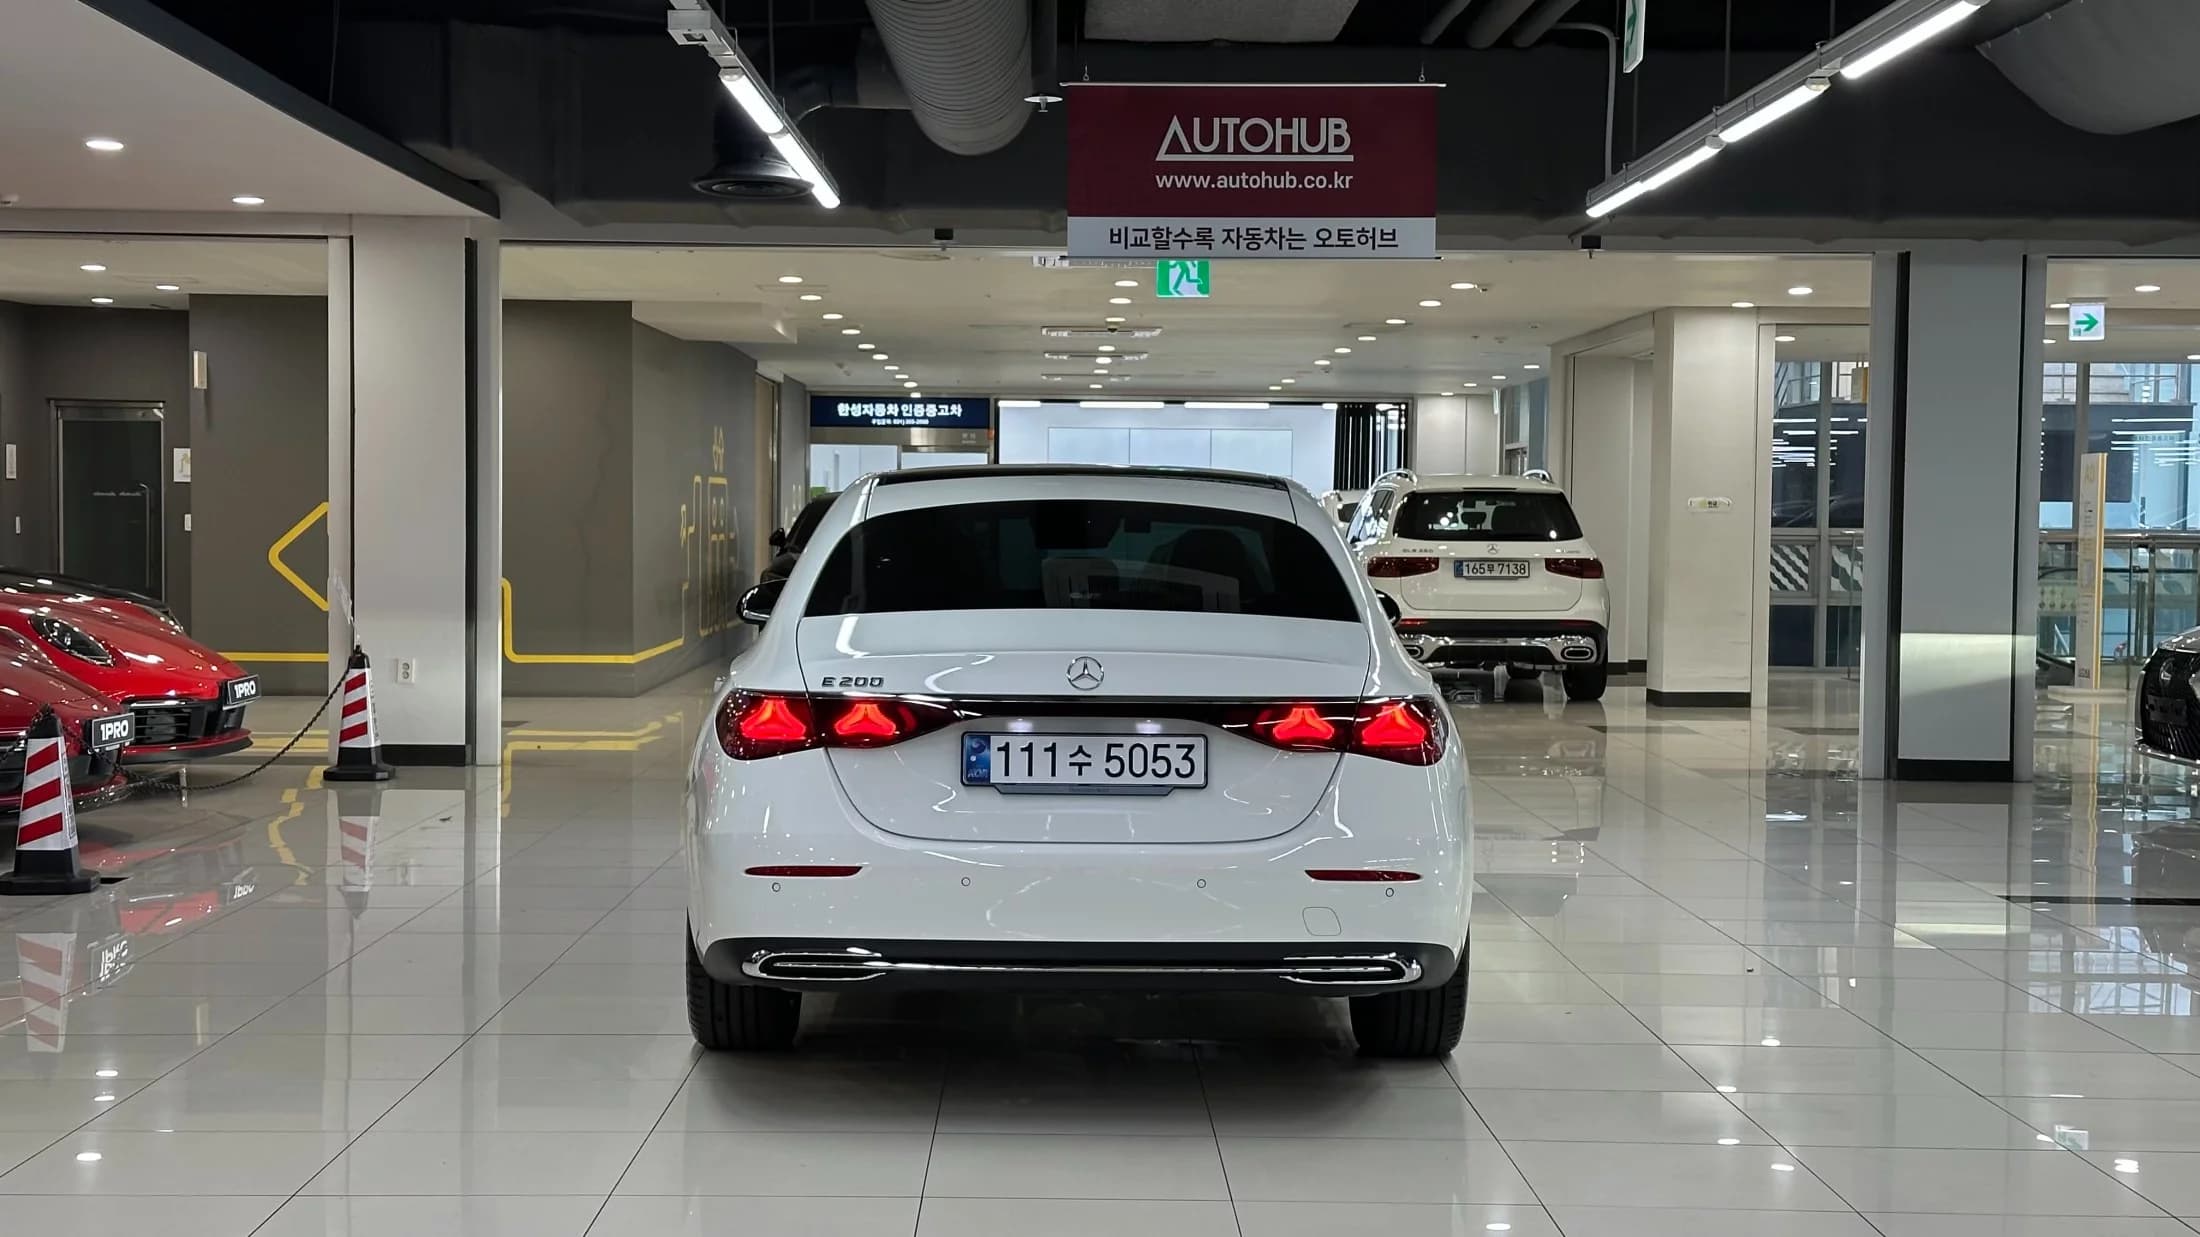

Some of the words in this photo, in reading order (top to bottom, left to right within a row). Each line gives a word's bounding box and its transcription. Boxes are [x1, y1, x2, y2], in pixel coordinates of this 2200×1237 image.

[1155, 115, 1354, 162] AUTOHUB
[1155, 171, 1354, 190] www.autohub.co.kr
[1109, 226, 1215, 251] 비교할수록
[1221, 226, 1307, 251] 자동차는
[1313, 227, 1399, 251] 오토허브
[1498, 563, 1526, 575] 7138
[234, 680, 256, 699] 1PRO
[821, 676, 836, 687] E
[839, 676, 884, 687] 200
[100, 719, 129, 741] 1PRO
[996, 741, 1093, 778] 111수
[1104, 742, 1197, 779] 5053
